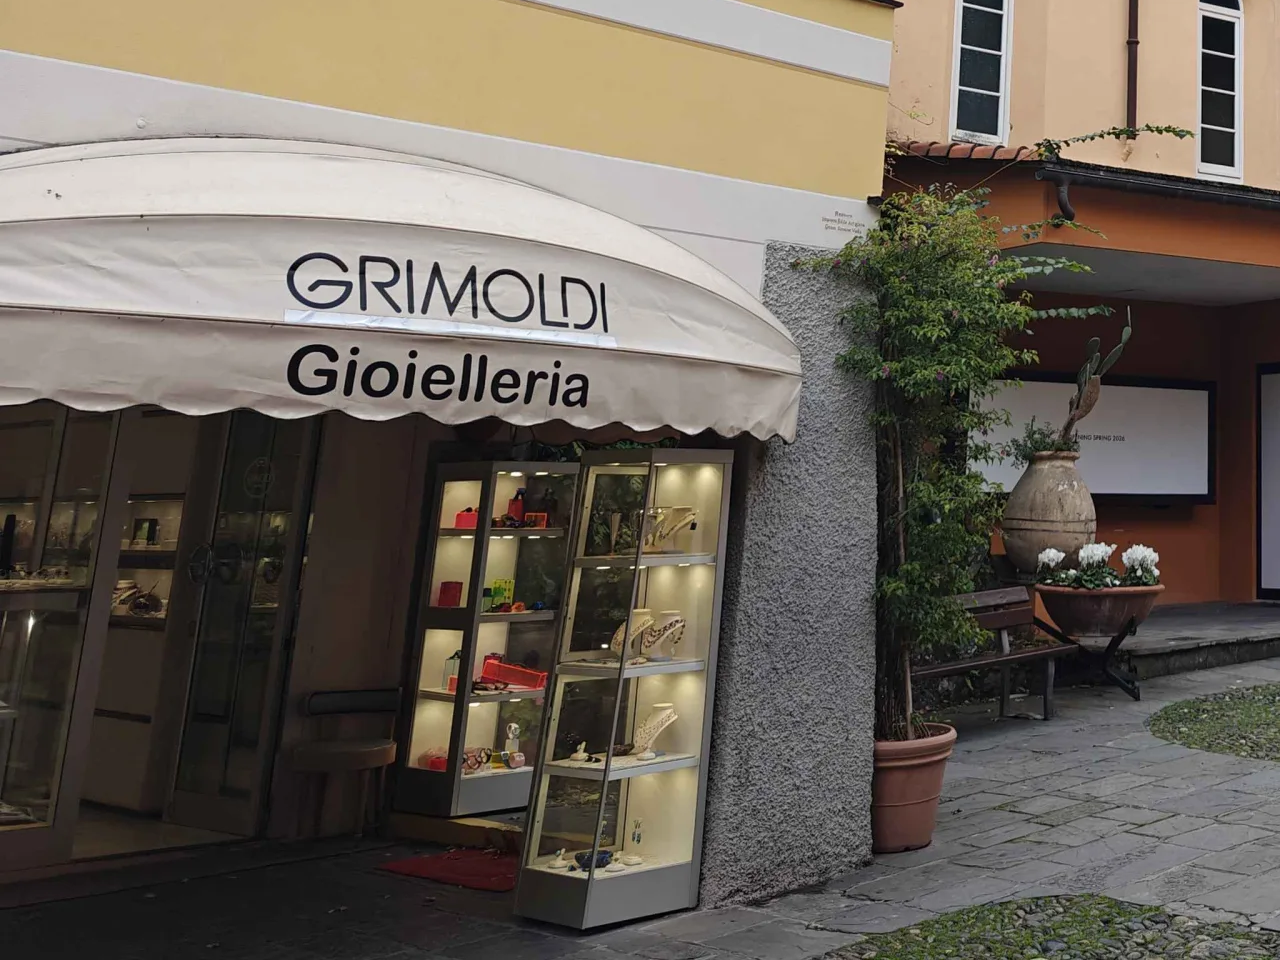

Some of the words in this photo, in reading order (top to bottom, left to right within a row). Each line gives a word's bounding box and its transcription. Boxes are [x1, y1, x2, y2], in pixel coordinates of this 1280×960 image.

[286, 251, 609, 334] GRIMOLDI
[286, 343, 591, 409] Gioielleria
[1093, 434, 1112, 442] SPRING
